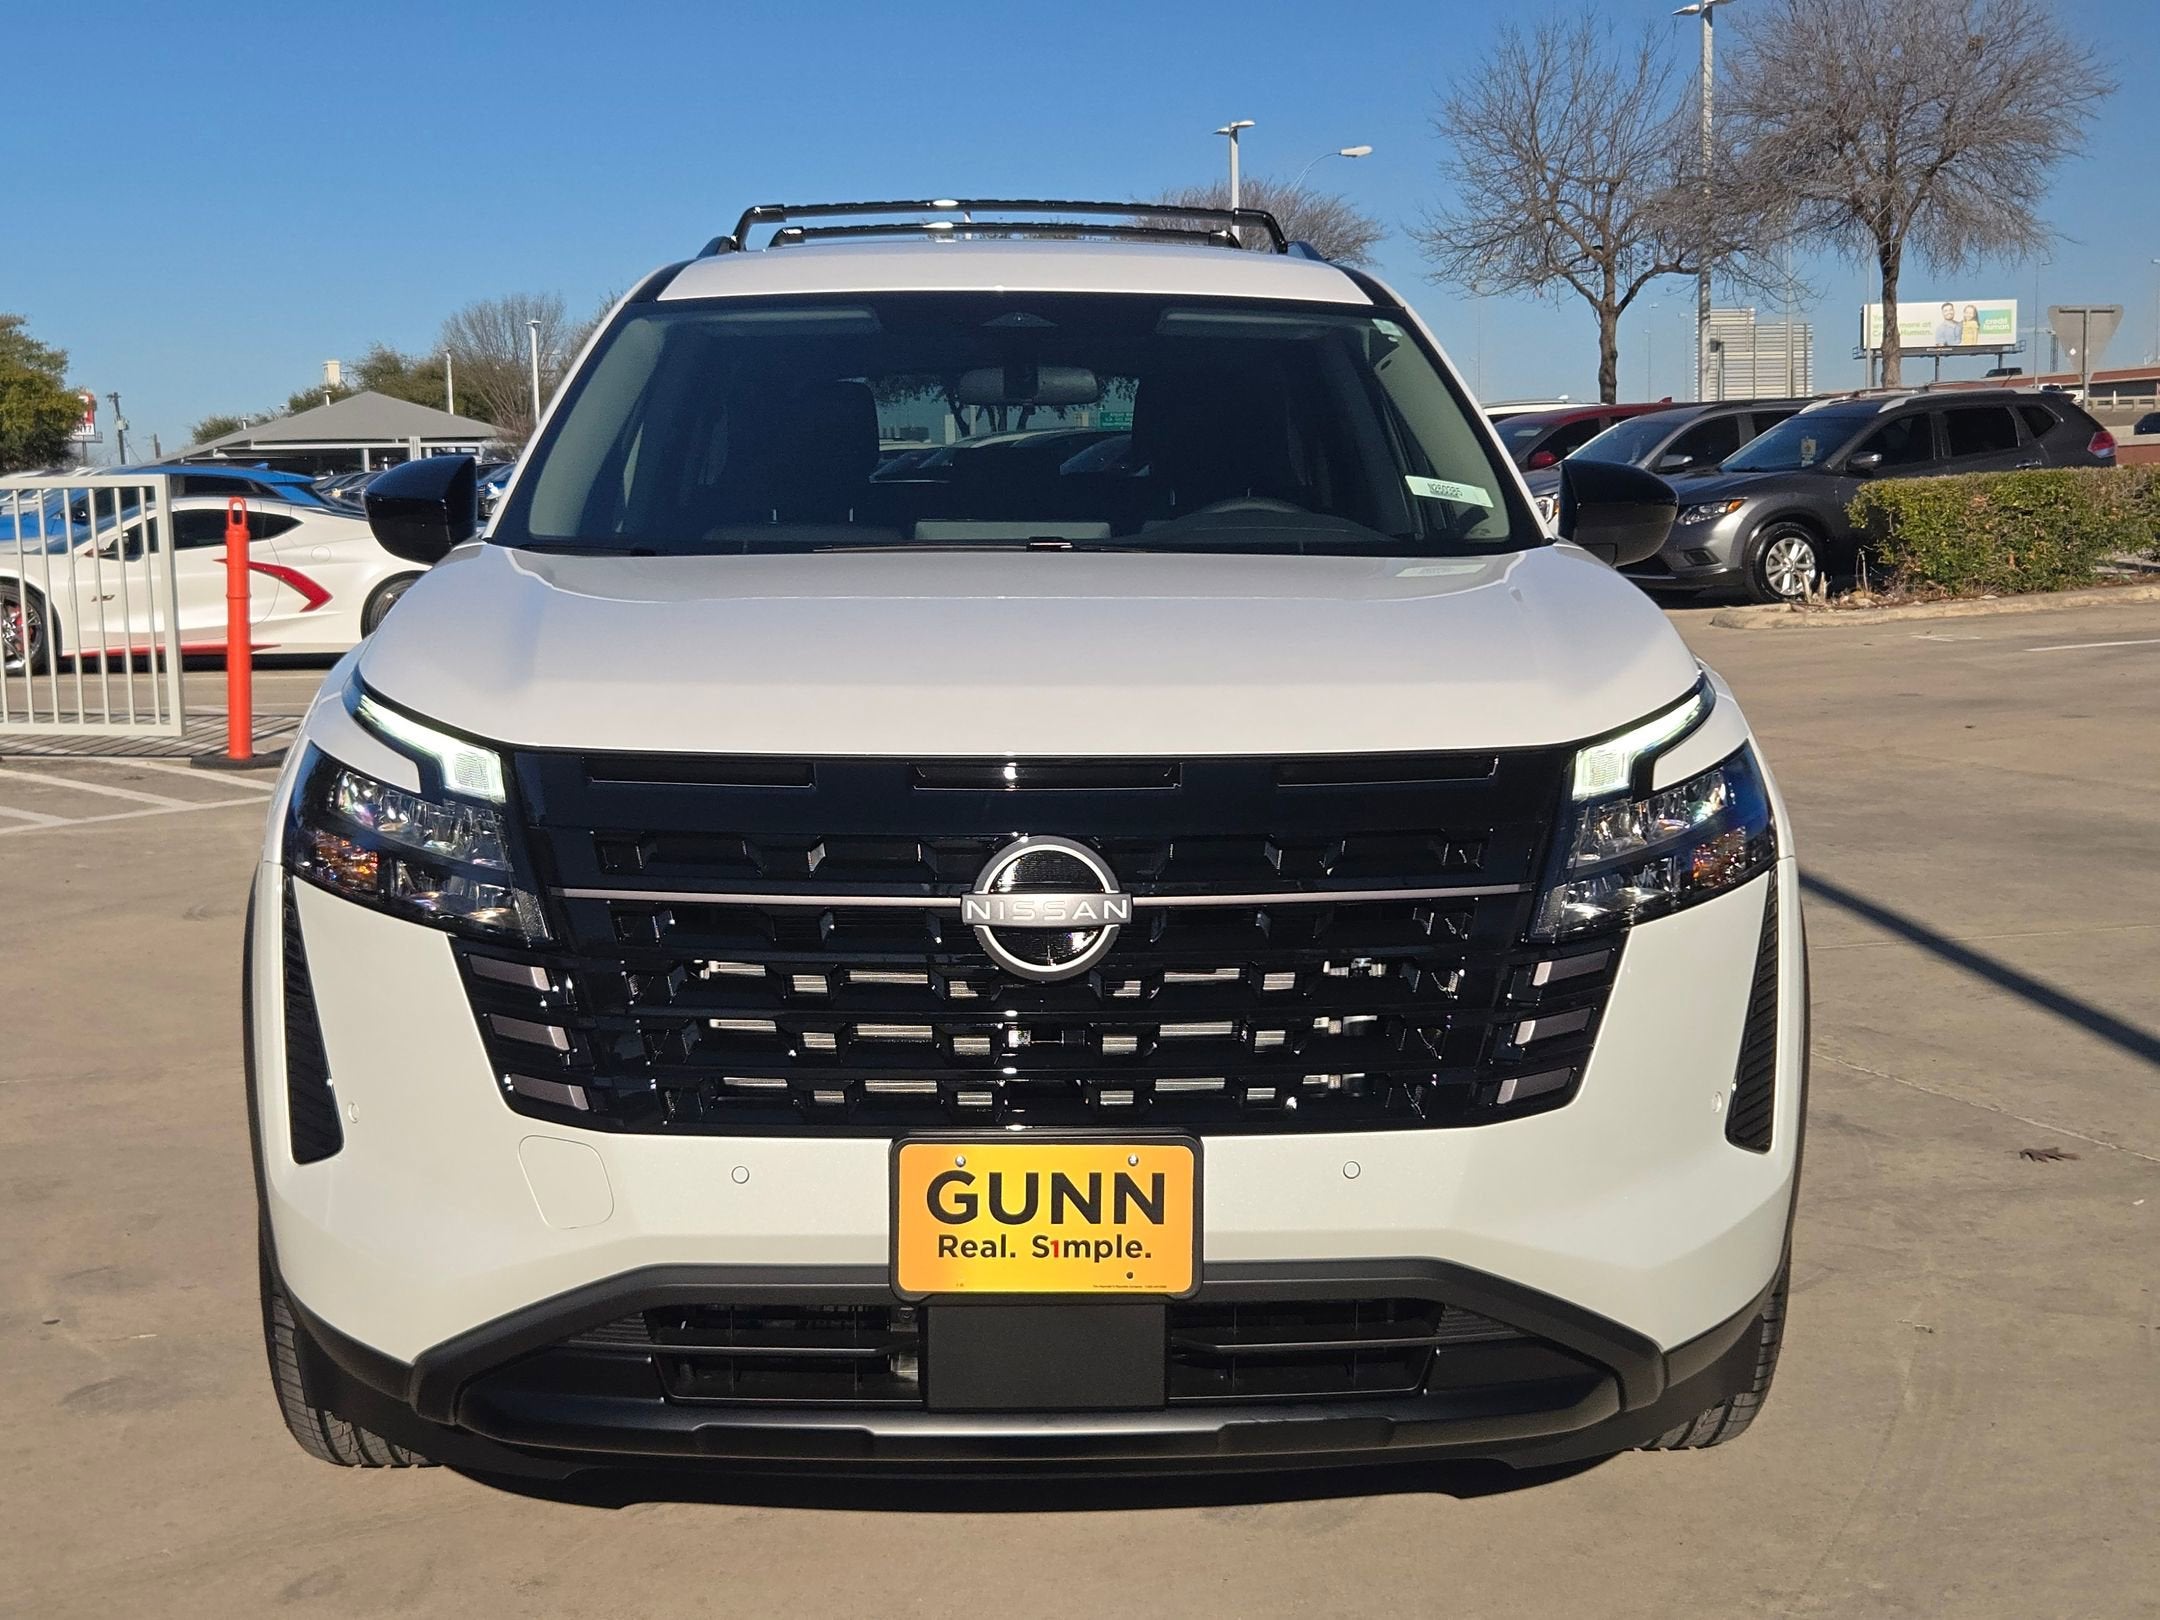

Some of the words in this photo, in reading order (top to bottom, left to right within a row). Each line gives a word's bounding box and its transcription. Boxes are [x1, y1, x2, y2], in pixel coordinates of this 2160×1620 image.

[967, 900, 1127, 920] NISSAN
[926, 1170, 1165, 1225] GUNN
[938, 1234, 1016, 1258] Real.
[1032, 1234, 1152, 1263] S1mple.
